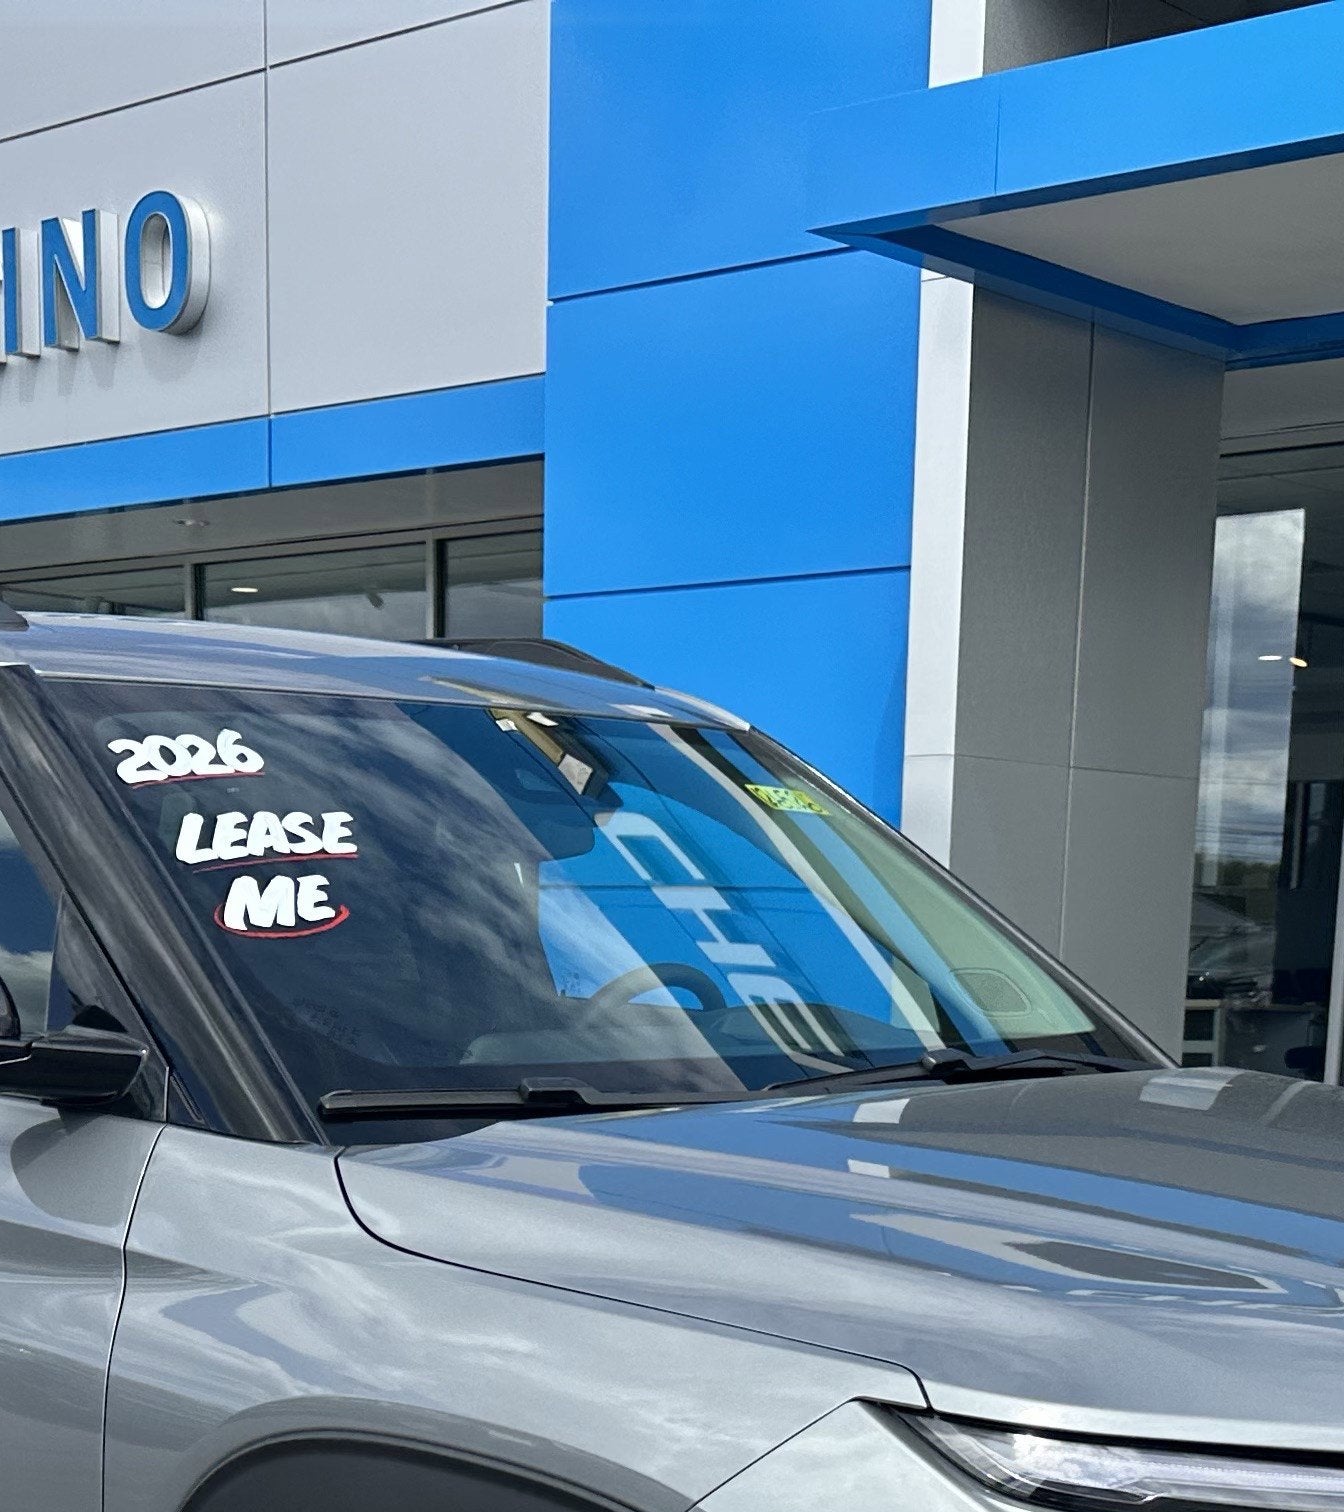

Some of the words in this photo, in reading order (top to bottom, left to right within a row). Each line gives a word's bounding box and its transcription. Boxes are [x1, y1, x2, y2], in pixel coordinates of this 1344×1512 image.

[108, 729, 265, 784] 2026
[176, 811, 358, 865] LEASE
[223, 874, 336, 930] ME
